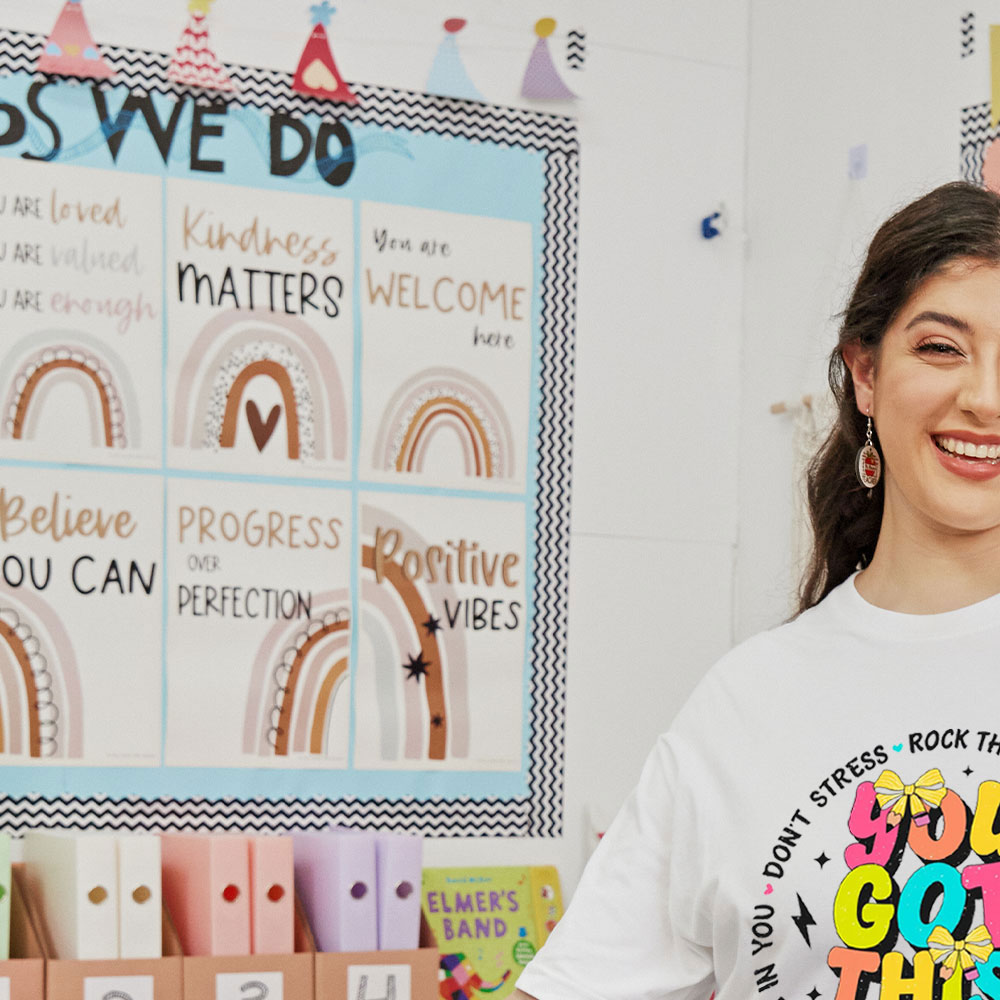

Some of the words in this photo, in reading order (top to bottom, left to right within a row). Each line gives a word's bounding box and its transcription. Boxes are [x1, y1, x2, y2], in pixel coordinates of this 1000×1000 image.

[91, 84, 230, 173] WE
[269, 112, 355, 187] DO
[13, 196, 43, 219] ARE
[50, 188, 127, 229] loved
[13, 243, 43, 266] ARE
[51, 236, 144, 276] valued
[182, 206, 339, 267] Kindness
[373, 228, 413, 256] You
[419, 238, 452, 258] are
[177, 261, 344, 318] MATTERS
[365, 269, 527, 322] WELCOME
[13, 290, 43, 313] ARE
[50, 291, 157, 336] enough
[472, 325, 516, 351] here
[0, 488, 138, 543] Believe
[179, 505, 343, 551] PROGRESS
[2, 555, 52, 592] OU
[71, 554, 157, 596] CAN
[187, 553, 221, 573] OVER
[374, 525, 521, 588] Positive
[178, 584, 312, 620] PERFECTION
[444, 598, 523, 631] VIBES
[908, 729, 970, 754] ROCK
[763, 809, 811, 879] DON'T
[809, 745, 889, 808] STRESS
[427, 890, 519, 913] ELMER'S
[443, 918, 507, 940] BAND
[751, 904, 775, 956] YOU
[753, 963, 779, 993] IN
